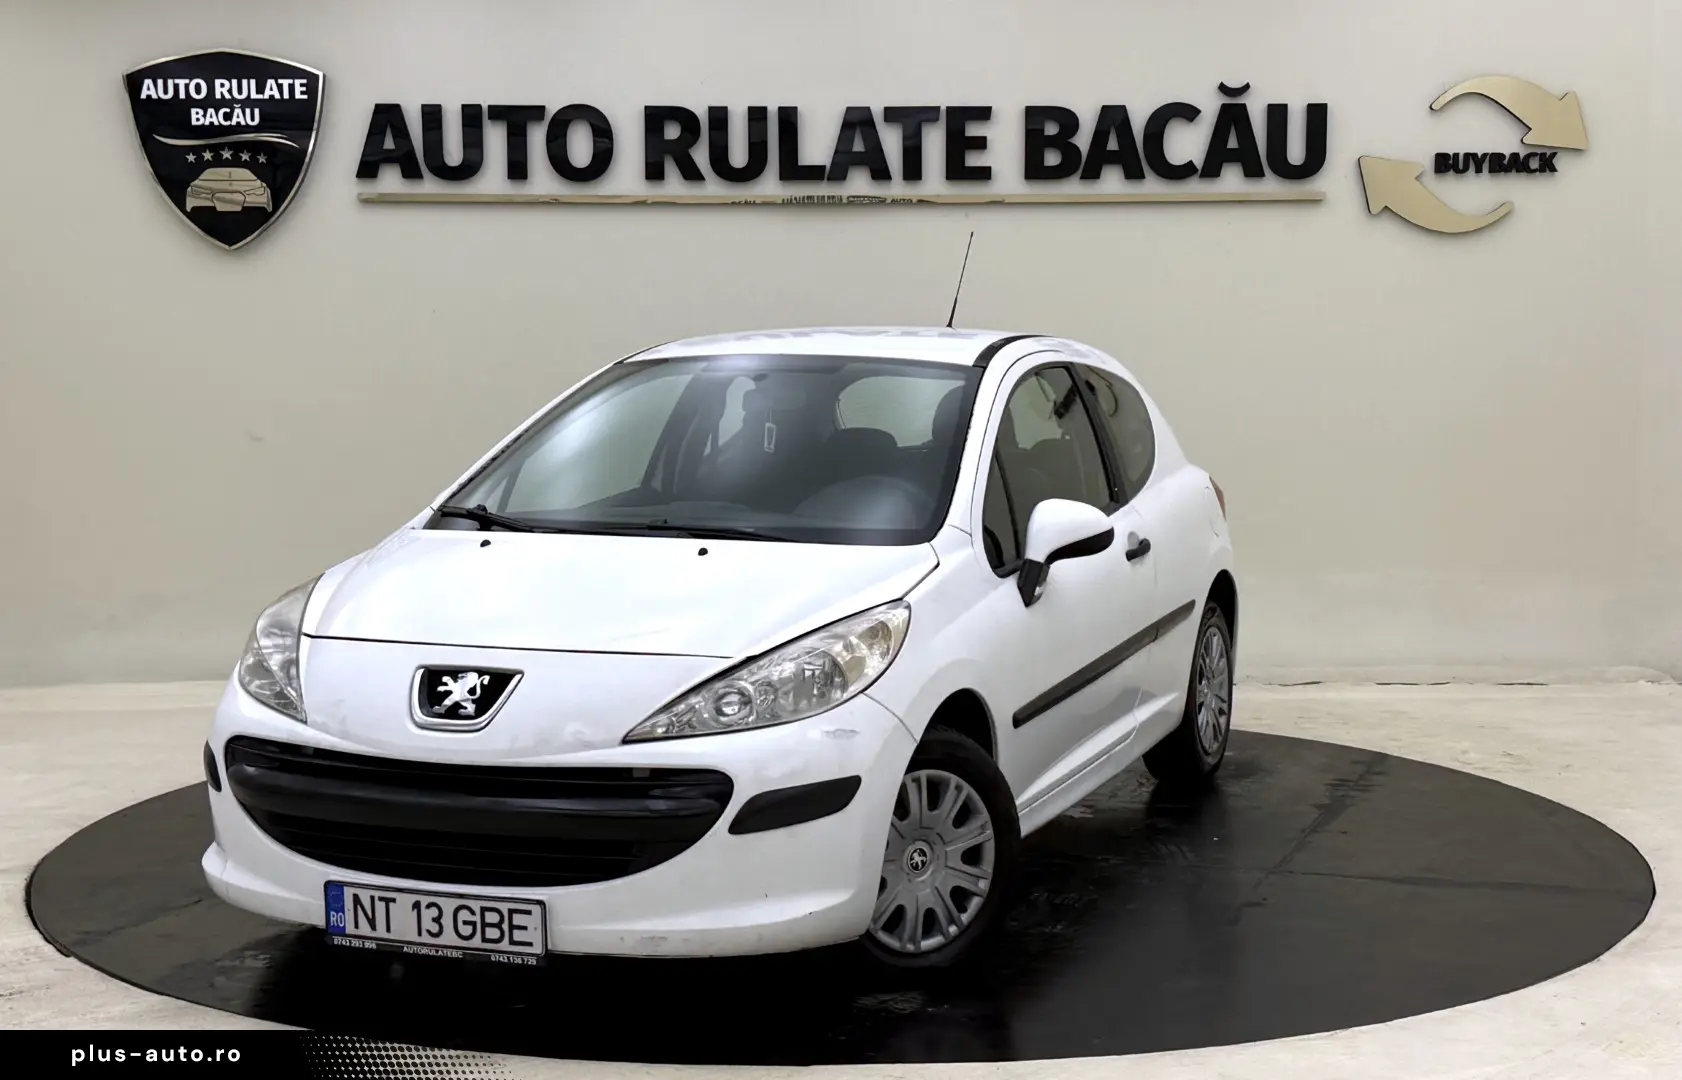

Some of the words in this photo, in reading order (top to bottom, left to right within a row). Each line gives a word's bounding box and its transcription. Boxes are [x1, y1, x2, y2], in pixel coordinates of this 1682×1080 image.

[140, 79, 208, 99] AUTO
[214, 79, 308, 100] RULATE
[190, 103, 260, 126] BACĂU
[355, 103, 613, 183] AUTO
[644, 105, 993, 183] RULATE
[1023, 81, 1328, 182] BACĂU
[1434, 151, 1558, 175] BUYBACK
[330, 910, 345, 927] RO
[352, 892, 397, 934] NT
[411, 900, 445, 938] 13
[452, 904, 534, 947] GBE
